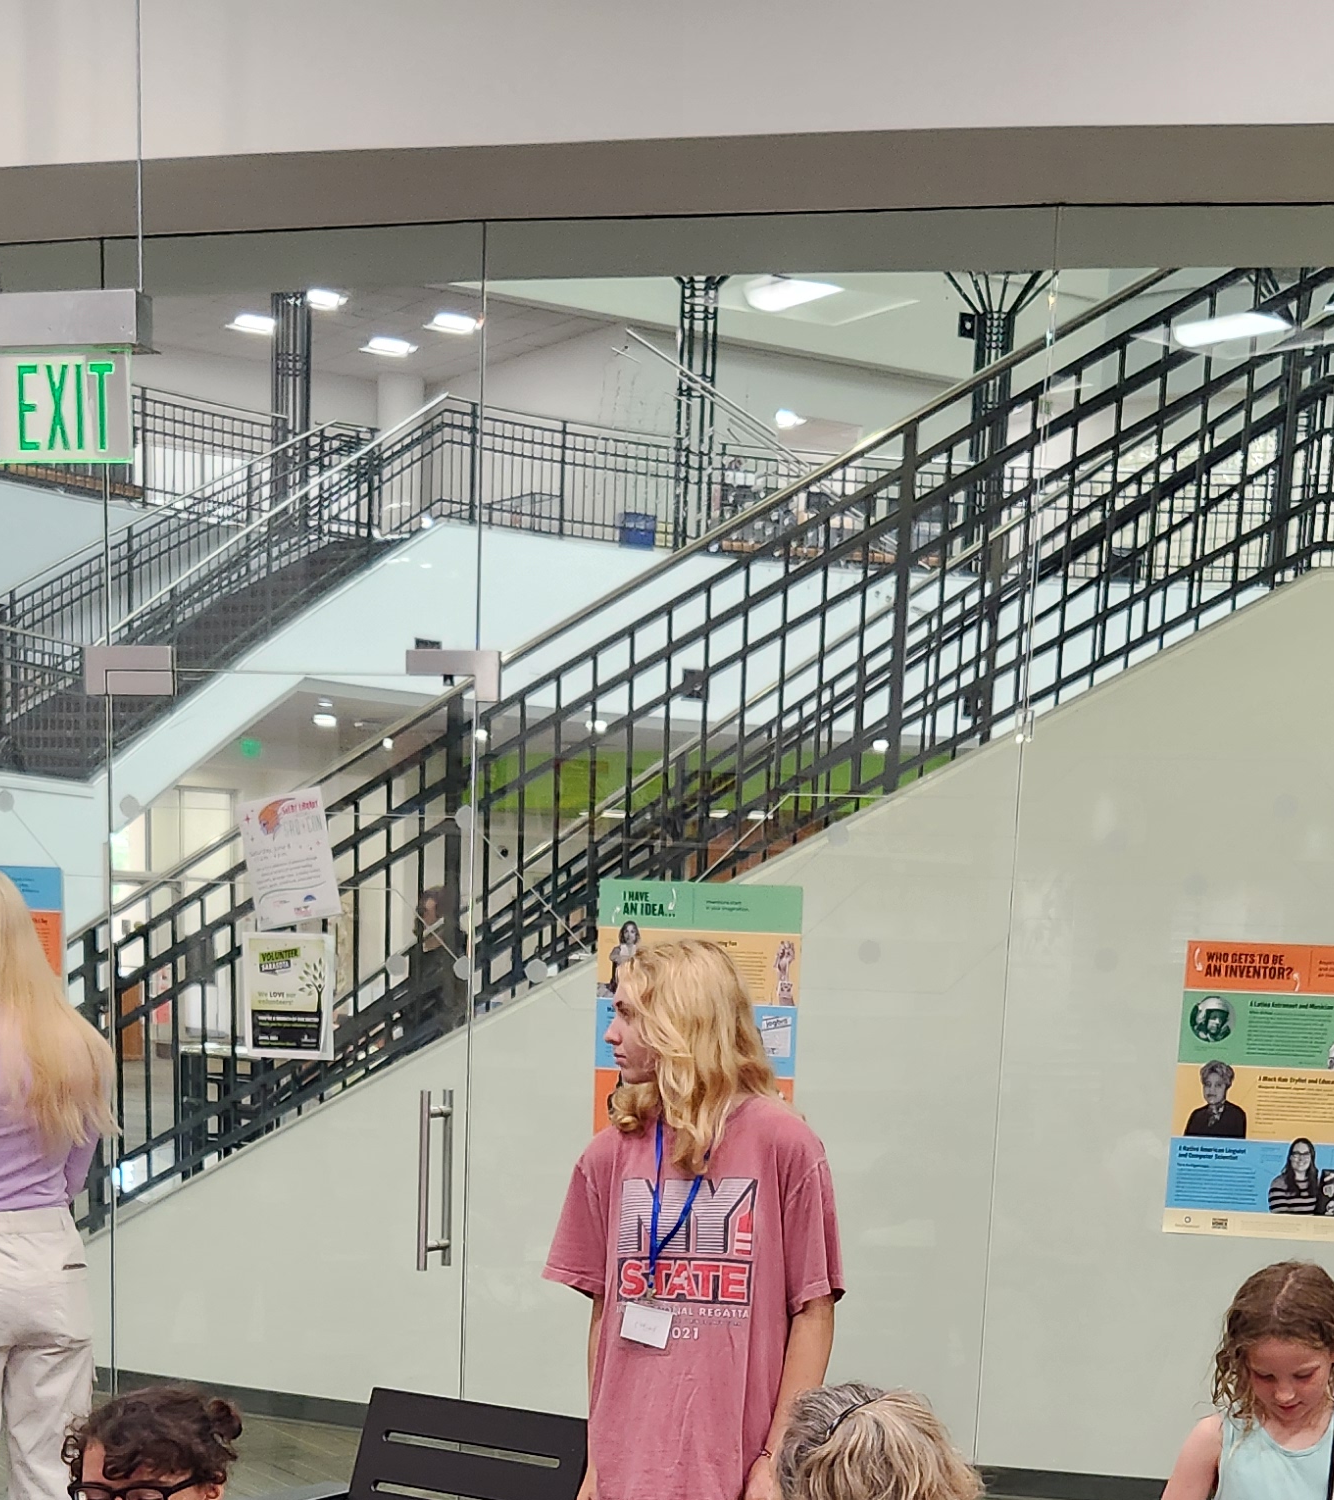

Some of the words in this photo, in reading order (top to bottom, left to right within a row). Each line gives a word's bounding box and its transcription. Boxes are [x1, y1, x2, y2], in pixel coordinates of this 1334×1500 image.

[17, 360, 114, 451] EXIT
[623, 891, 626, 901] I
[628, 891, 650, 902] HAVE
[622, 902, 638, 915] AN
[640, 903, 676, 917] IDEA...
[261, 948, 299, 961] VOLUNTEER
[1206, 951, 1228, 964] WHO
[1231, 952, 1255, 965] GETS
[1258, 953, 1270, 965] TO
[1272, 954, 1285, 965] BE
[1205, 963, 1221, 978] AN
[1224, 964, 1293, 980] INVENTOR?
[619, 1259, 748, 1300] STATE
[699, 1306, 749, 1319] REGATTA
[670, 1325, 699, 1340] 021
